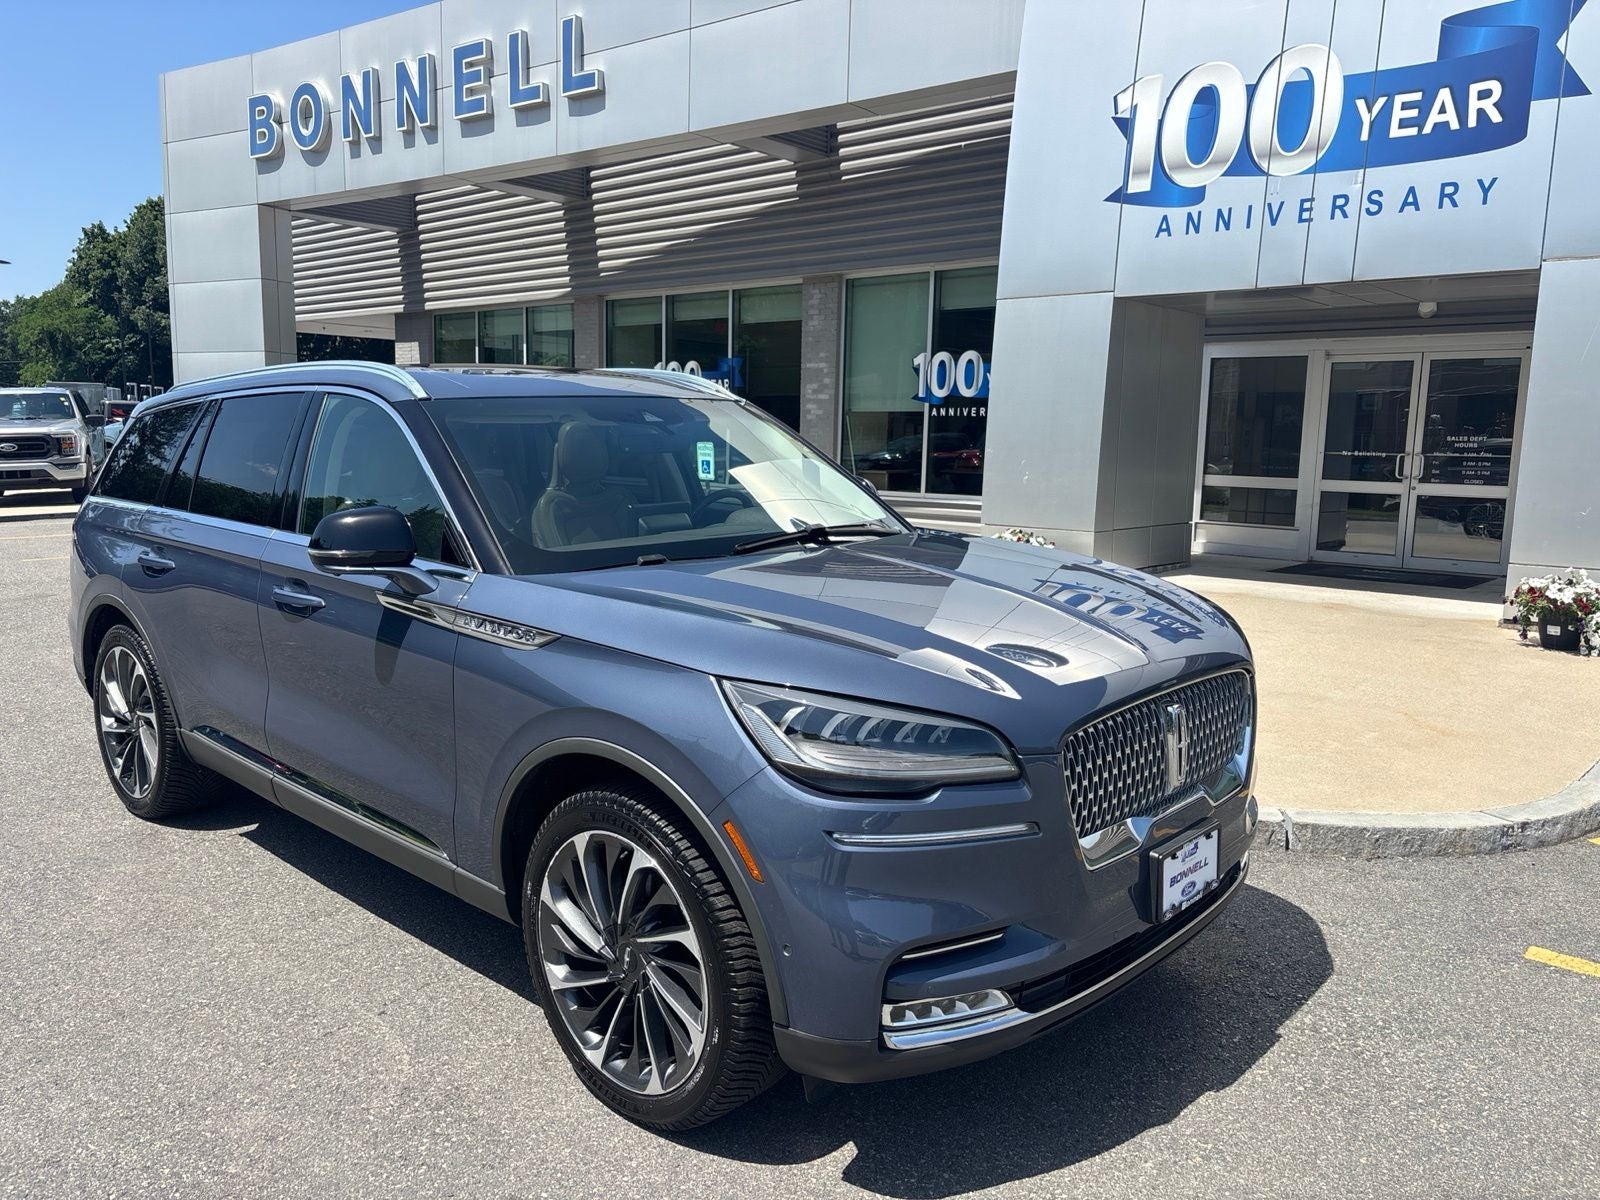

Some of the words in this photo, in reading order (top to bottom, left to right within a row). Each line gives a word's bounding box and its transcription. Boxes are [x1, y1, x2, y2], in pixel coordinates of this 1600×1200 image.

[247, 14, 604, 160] BONNELL
[1112, 43, 1344, 194] 100
[1355, 79, 1504, 142] YEAR
[1155, 177, 1498, 238] ANNIVERSARY
[912, 350, 984, 398] 100
[463, 616, 537, 643] AVIATOR
[1169, 857, 1209, 888] BONNELL
